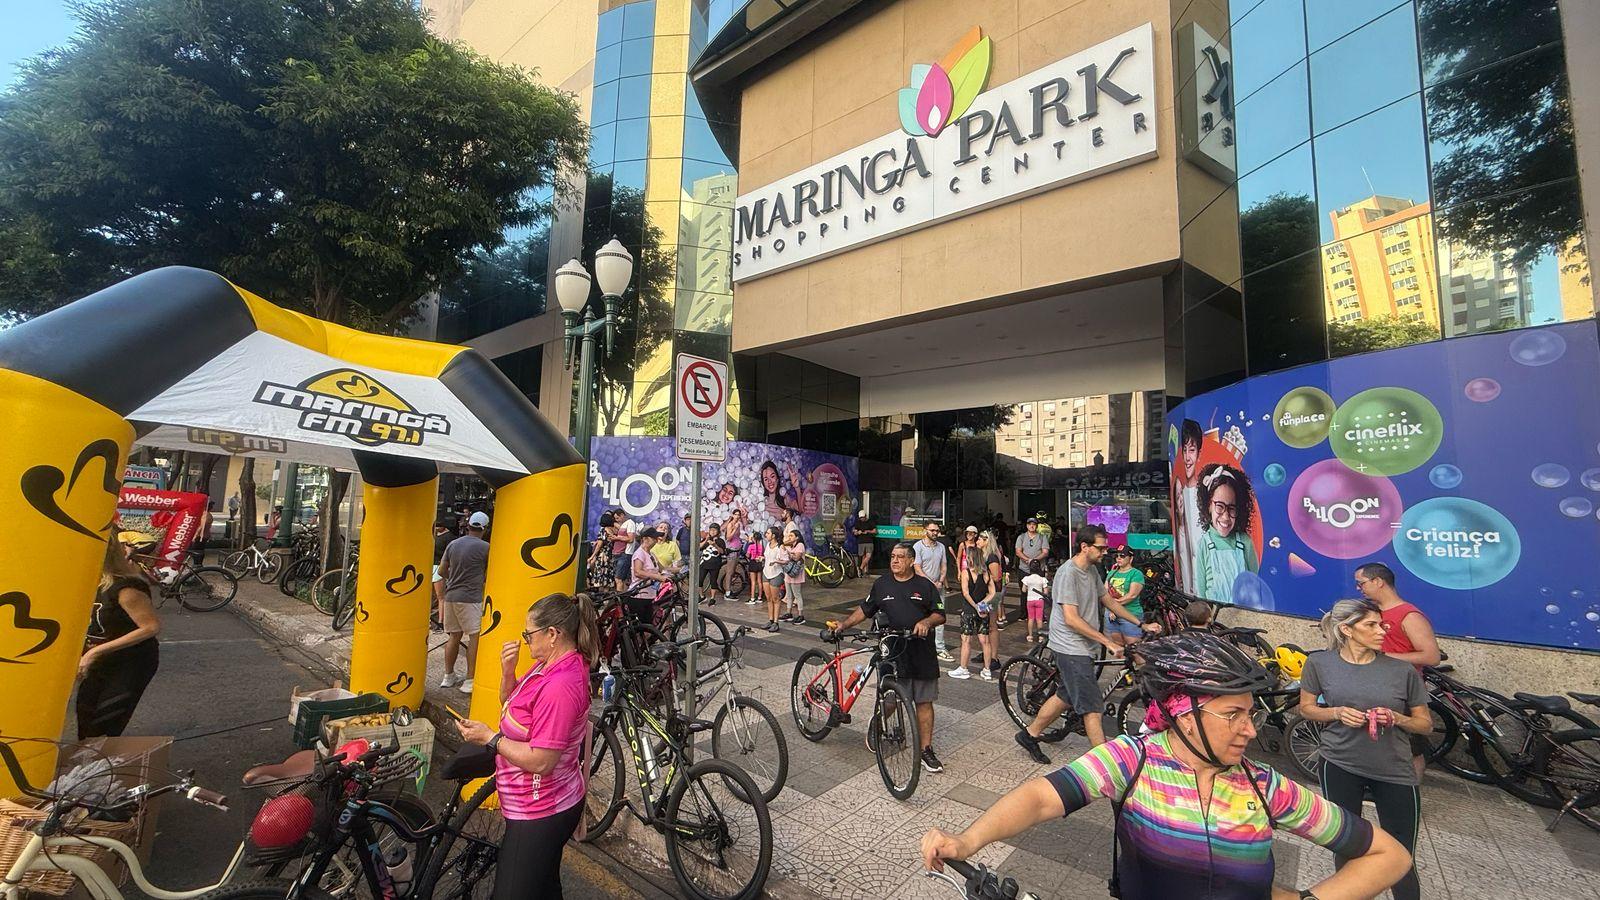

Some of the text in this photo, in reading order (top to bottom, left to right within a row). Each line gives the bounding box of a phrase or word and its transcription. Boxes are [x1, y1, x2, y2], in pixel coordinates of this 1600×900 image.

[735, 137, 932, 245] MARINGA
[953, 47, 1142, 166] PARK
[734, 112, 1147, 266] SHOPPING CENTER
[302, 412, 420, 444] FM 97.1
[687, 421, 718, 432] EMBARQUE
[1279, 412, 1325, 427] funplace
[1344, 420, 1424, 442] cineflix
[680, 437, 722, 448] DESEMBARQUE
[590, 461, 693, 516] BALLOON
[125, 493, 178, 505] Webber
[1303, 497, 1380, 528] BALLOON
[169, 513, 194, 550] Webber
[1406, 528, 1501, 547] Criança
[1145, 538, 1169, 546] VOCÊ
[1424, 543, 1480, 559] feliz!
